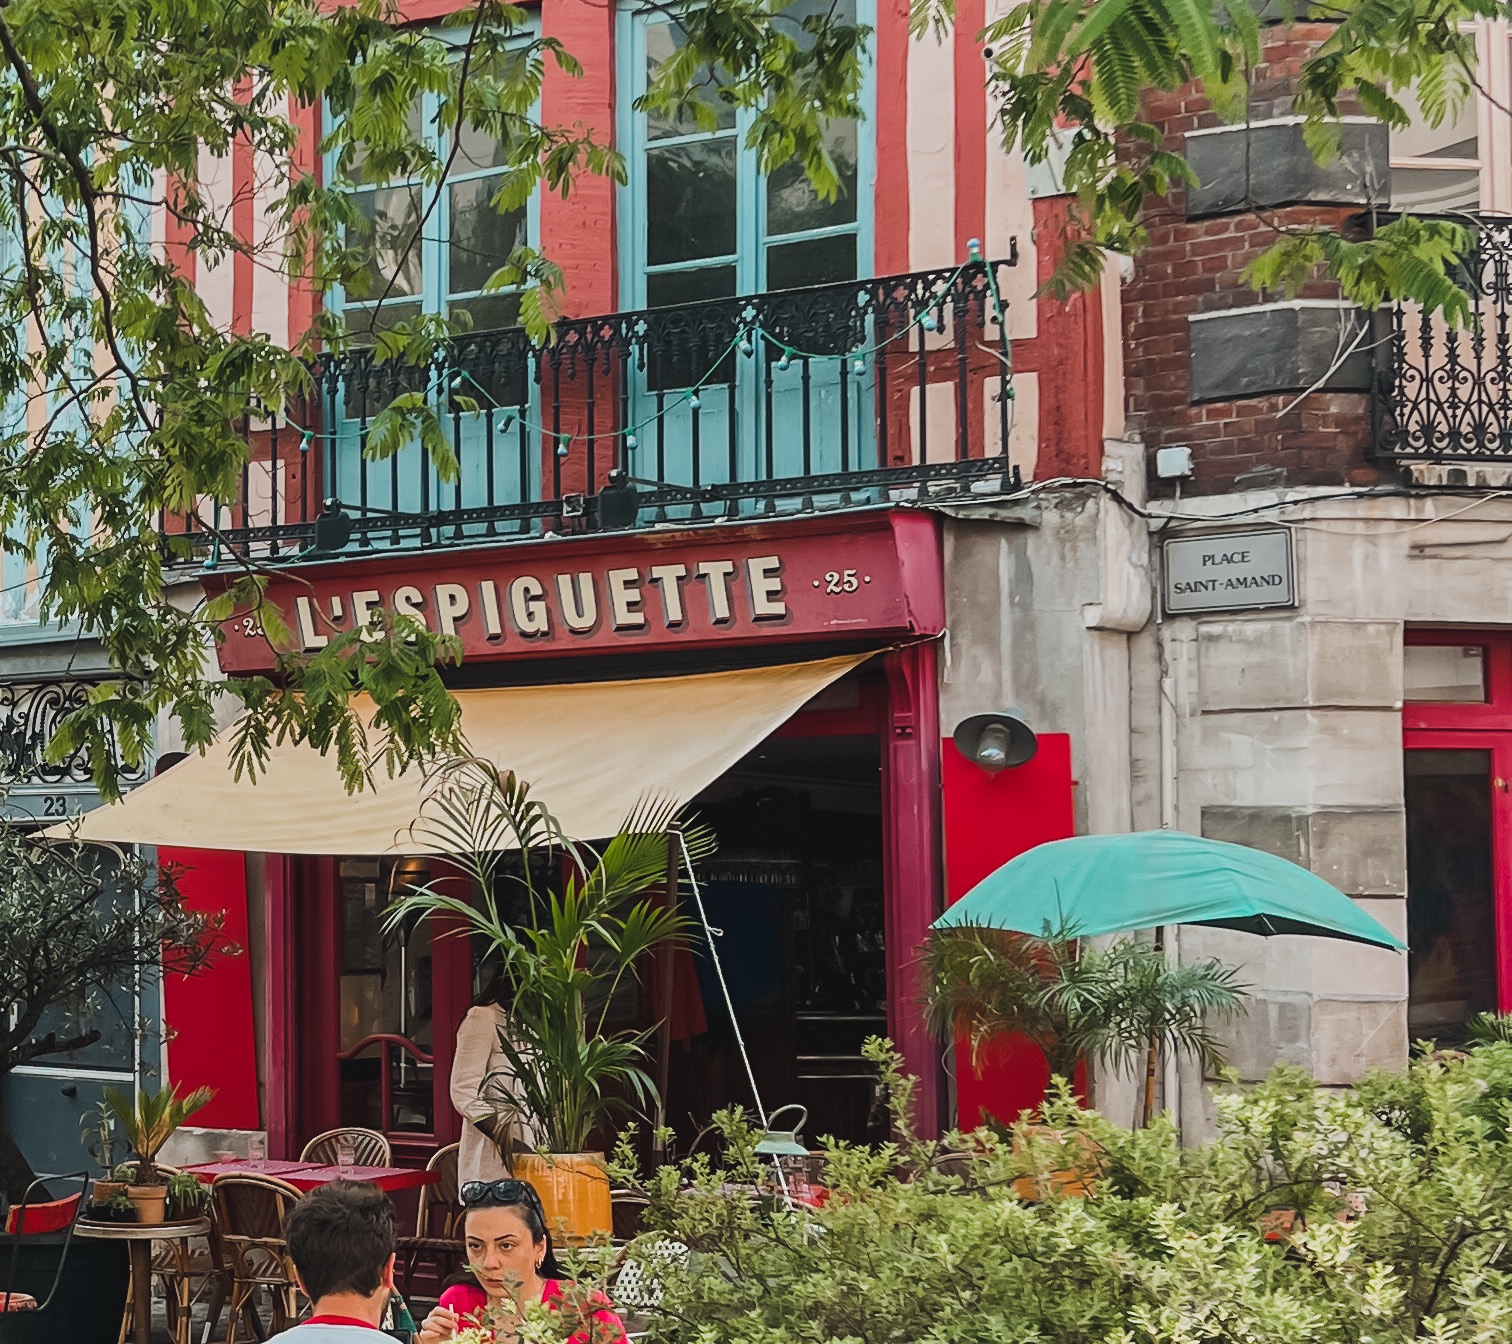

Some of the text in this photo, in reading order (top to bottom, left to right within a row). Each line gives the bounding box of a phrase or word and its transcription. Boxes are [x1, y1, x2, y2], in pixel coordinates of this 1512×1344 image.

[1202, 551, 1251, 567] PLACE
[824, 568, 859, 595] 25
[1173, 574, 1283, 594] SAINT-AMAND
[295, 555, 787, 649] L'ESPIGUETTE
[43, 796, 67, 816] 23
